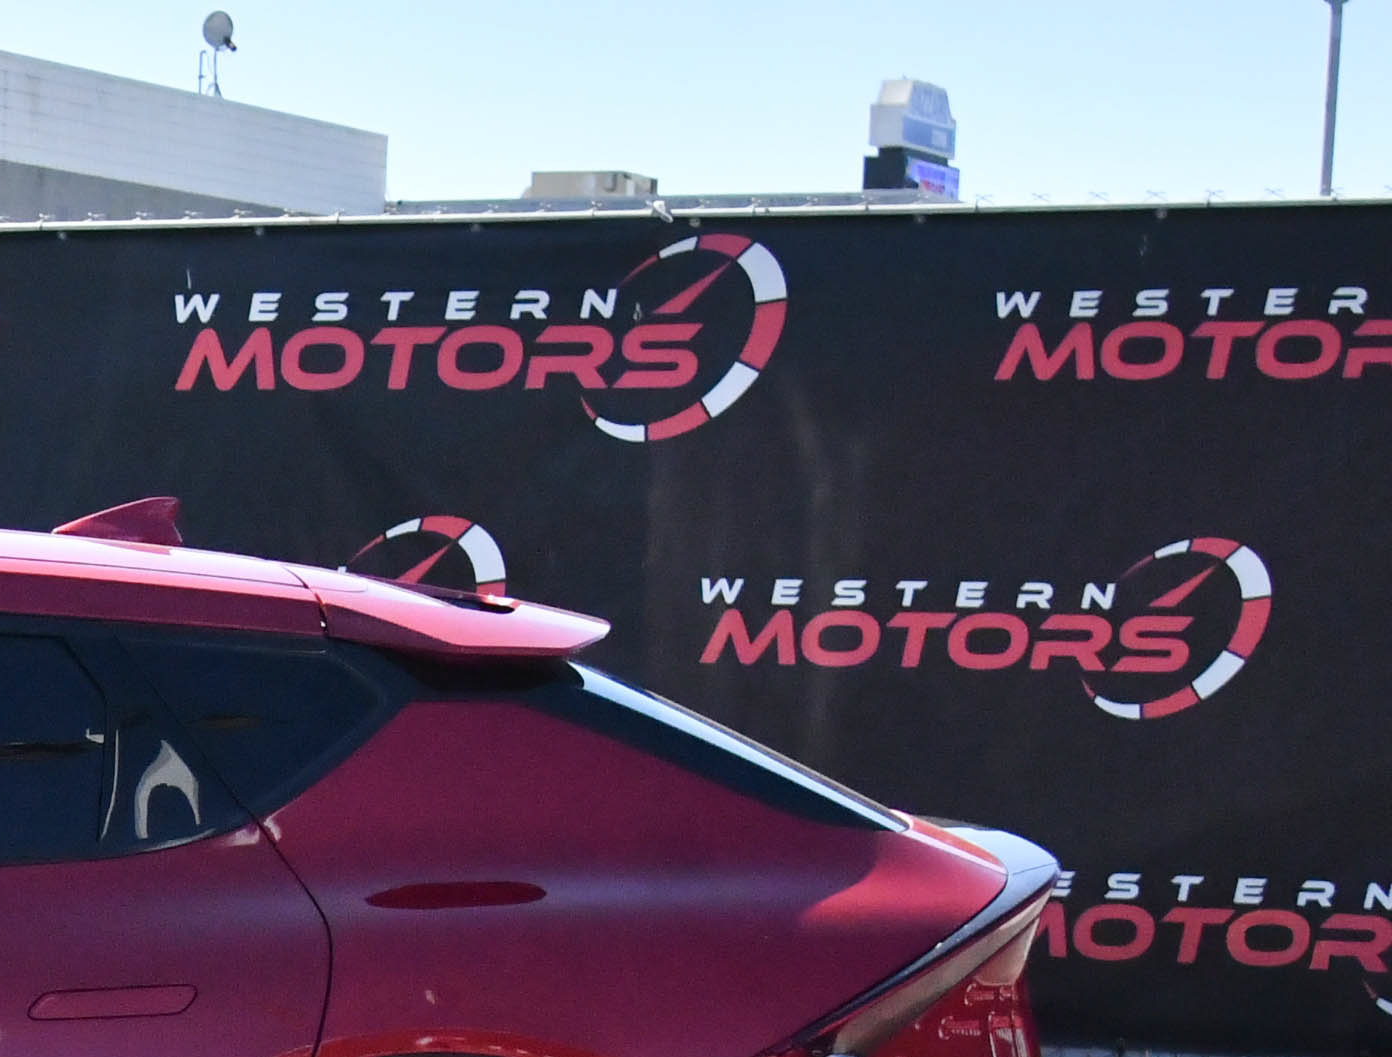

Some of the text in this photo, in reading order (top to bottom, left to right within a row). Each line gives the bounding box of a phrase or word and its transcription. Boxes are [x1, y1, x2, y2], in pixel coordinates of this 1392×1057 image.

[174, 288, 617, 323] WESTERN
[996, 287, 1368, 318] WESTER
[173, 323, 701, 391] MOTORS
[701, 577, 1116, 610] WESTERN
[700, 610, 1192, 673] MOTORS
[1050, 870, 1392, 910] ESTERN
